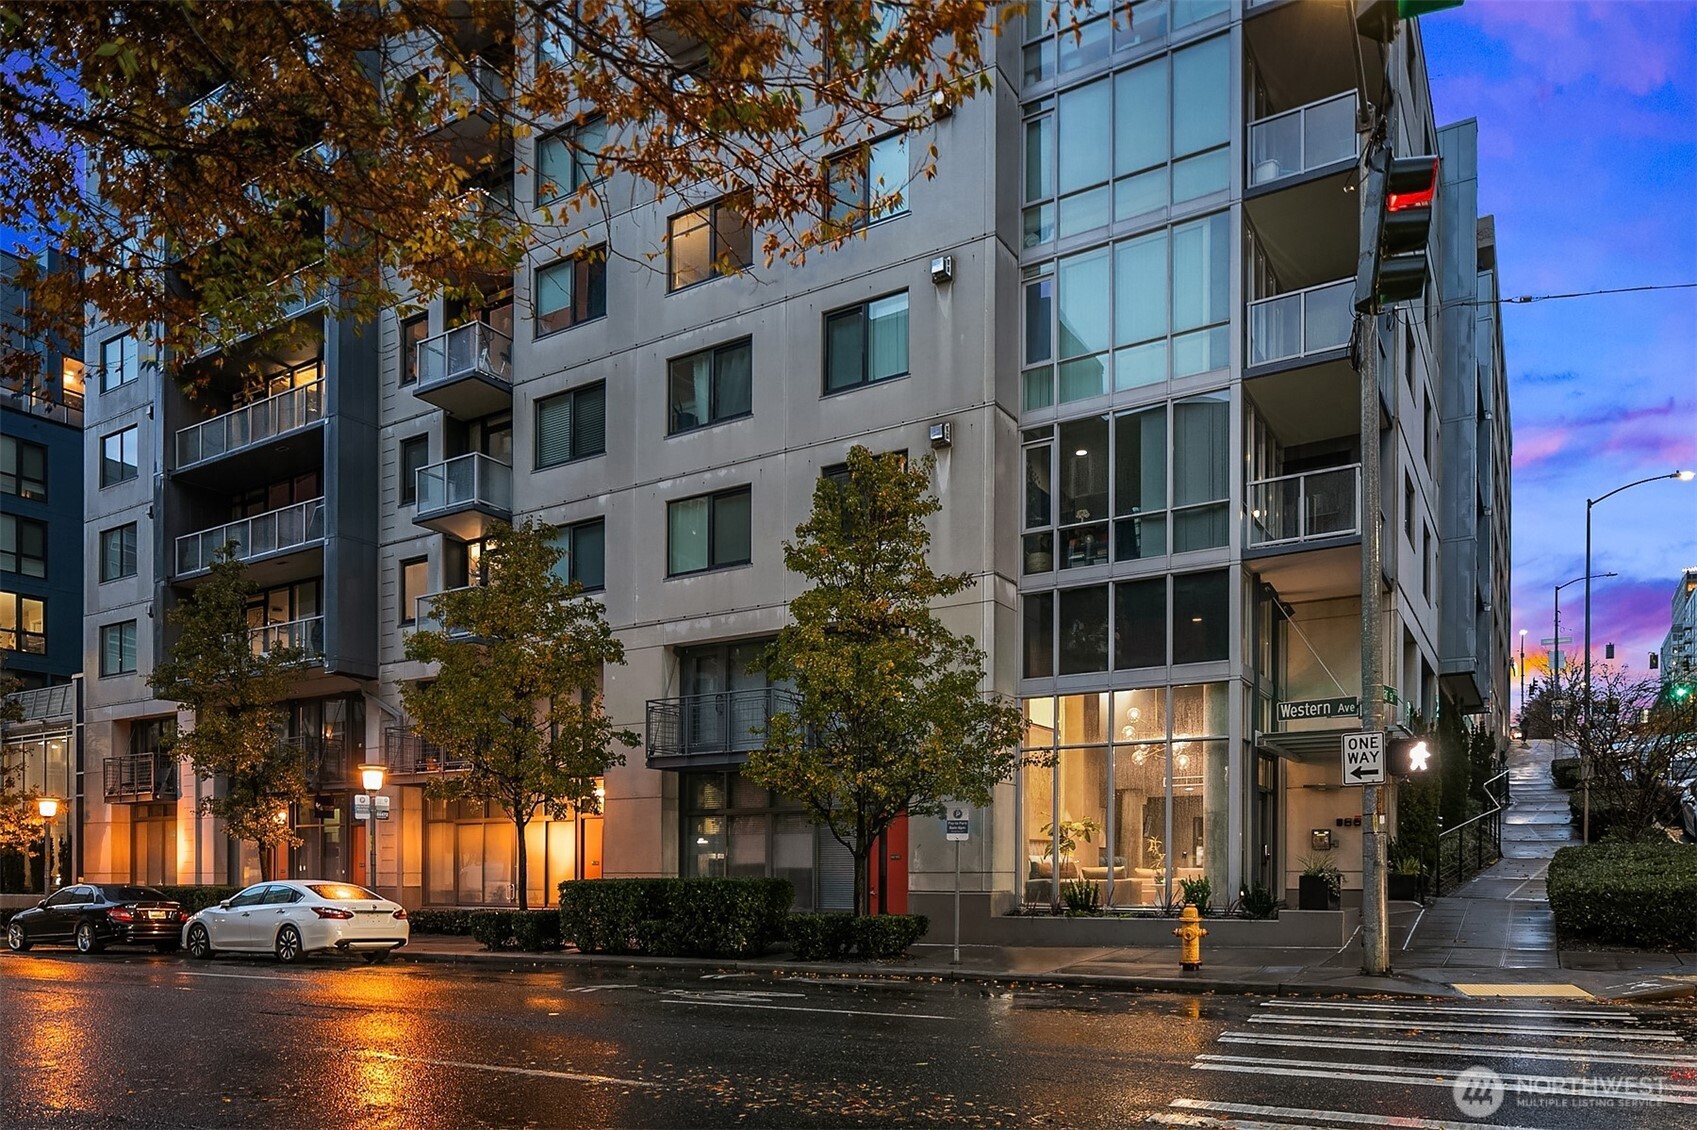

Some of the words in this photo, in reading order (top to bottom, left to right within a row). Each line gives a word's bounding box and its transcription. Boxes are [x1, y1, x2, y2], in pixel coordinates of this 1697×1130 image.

[1280, 702, 1331, 718] Western
[1337, 703, 1356, 713] Ave
[1348, 737, 1379, 751] ONE
[1348, 751, 1380, 764] WAY
